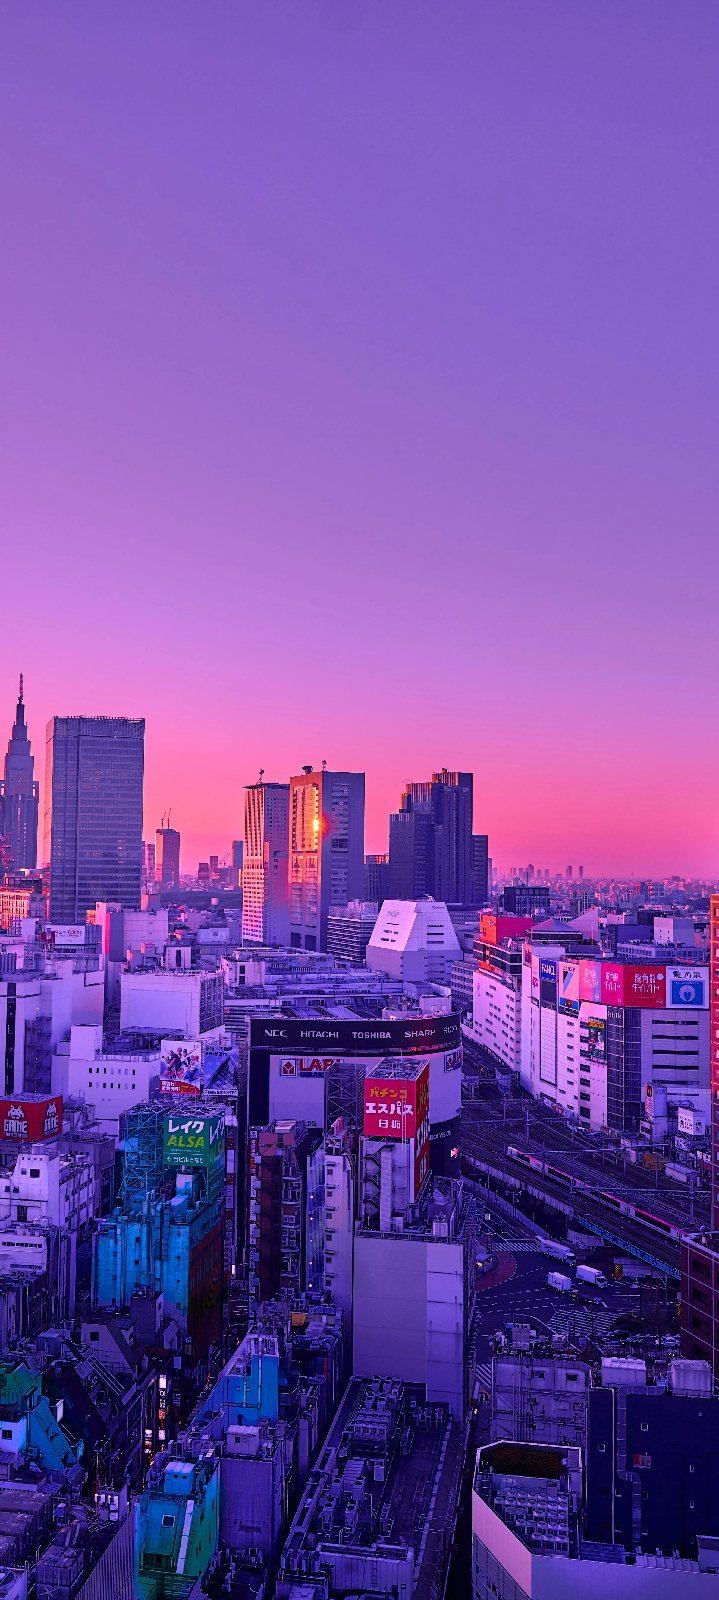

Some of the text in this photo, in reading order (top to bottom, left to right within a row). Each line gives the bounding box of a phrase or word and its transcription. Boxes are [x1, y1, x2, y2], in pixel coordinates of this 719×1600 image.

[264, 1029, 288, 1038] NEC
[300, 1030, 339, 1039] HITACHI
[351, 1031, 392, 1039] TOSHIBA
[404, 1029, 436, 1038] SHARP
[369, 1086, 408, 1099] パチンコ
[365, 1100, 414, 1116] エスパス
[168, 1119, 205, 1134] レイク
[166, 1135, 205, 1149] ALSA
